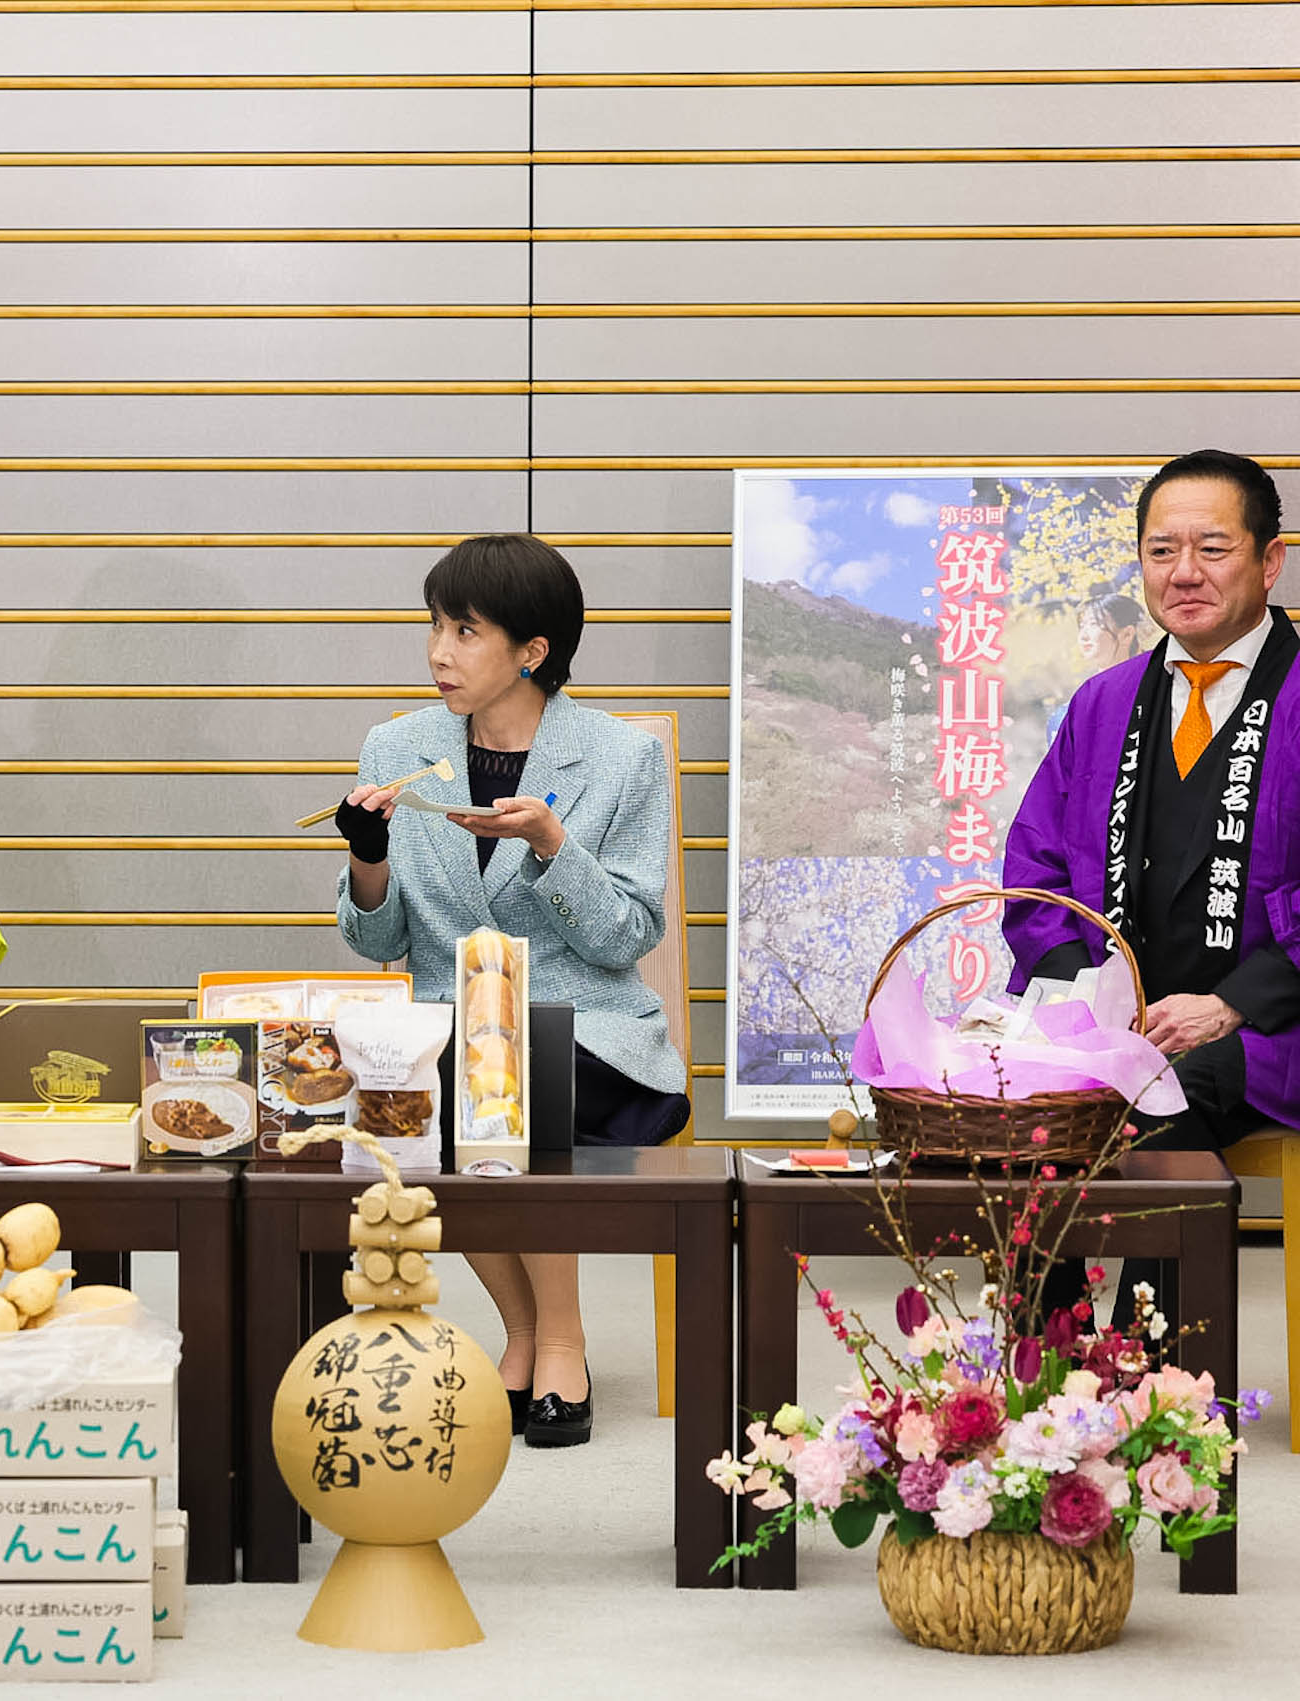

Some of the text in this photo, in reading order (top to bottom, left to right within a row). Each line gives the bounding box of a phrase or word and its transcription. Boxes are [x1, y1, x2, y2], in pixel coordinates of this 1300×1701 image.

[939, 506, 1005, 525] 第53回
[936, 533, 1006, 999] 筑波山梅まつり
[1205, 699, 1269, 951] 日本百名山 筑波山
[260, 1028, 287, 1153] WAGYU
[50, 1398, 157, 1412] 土浦れんこんセンター
[28, 1501, 136, 1515] 土浦れんこんセンター
[28, 1603, 136, 1617] 土浦れんこんセンター
